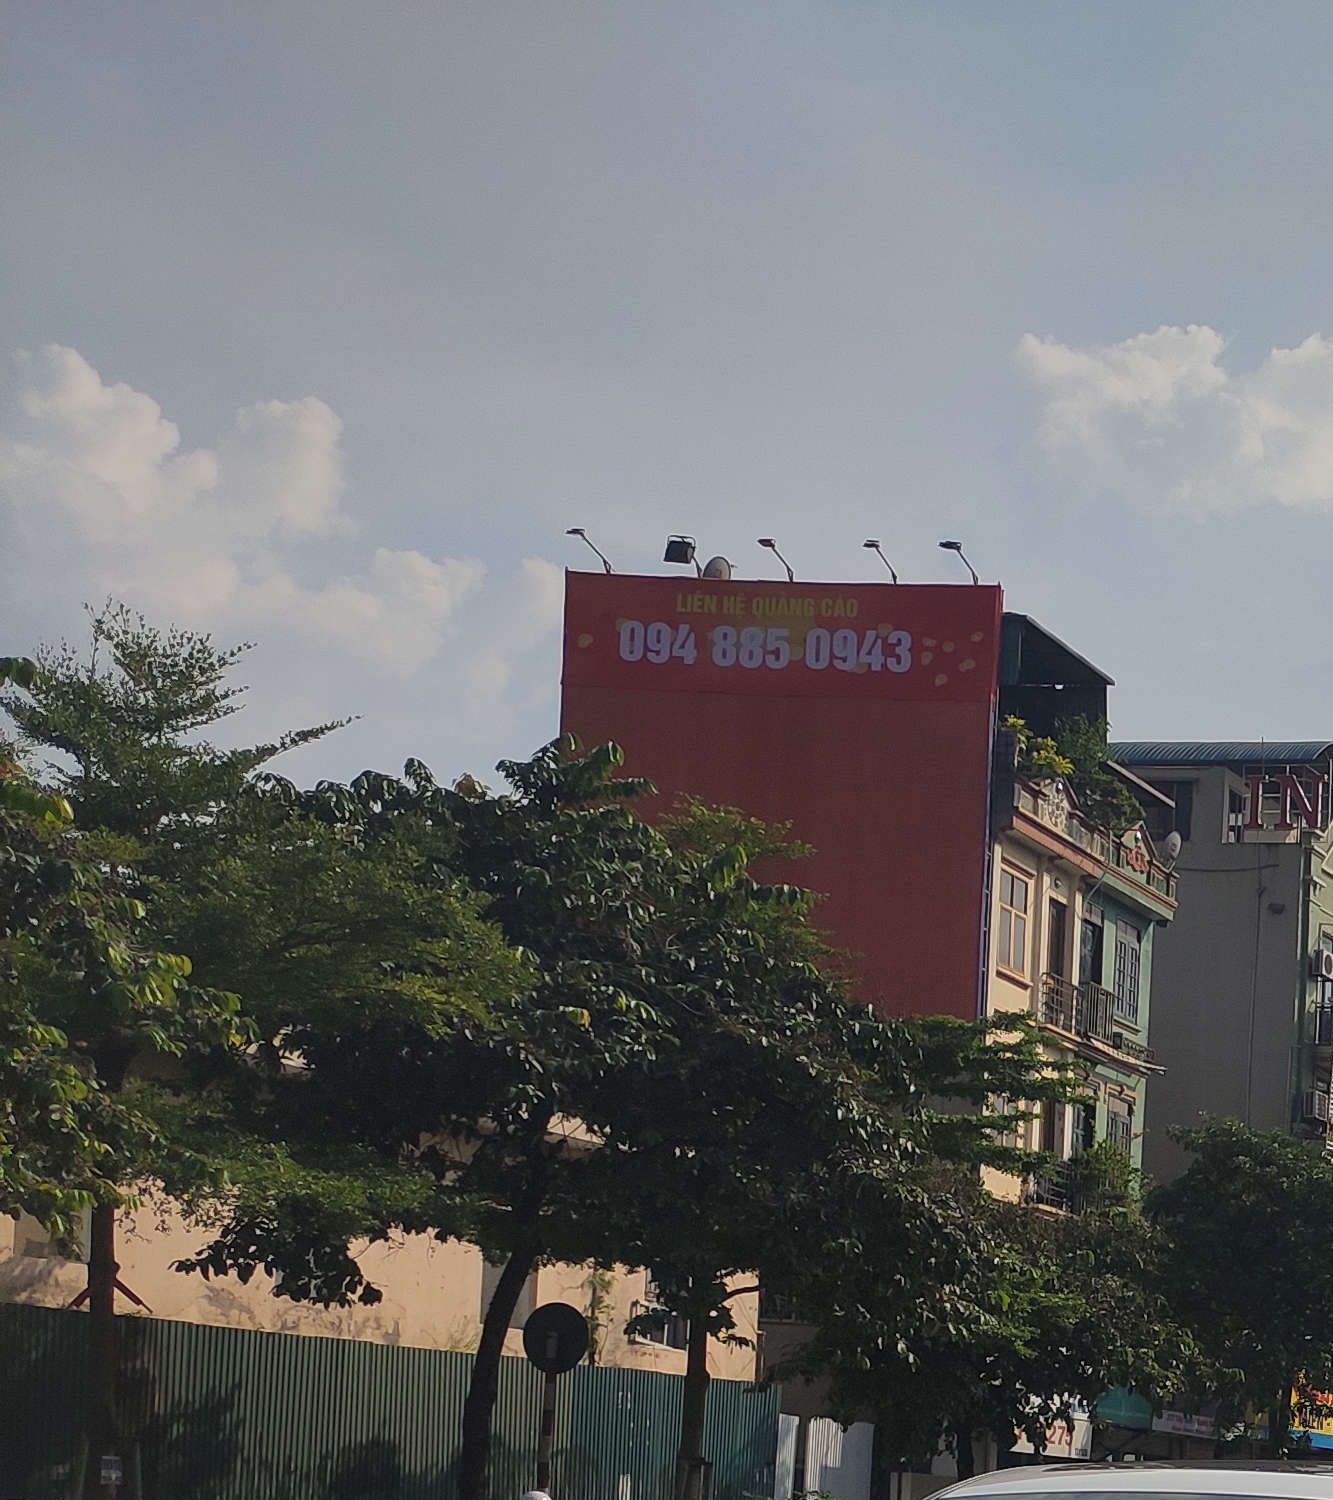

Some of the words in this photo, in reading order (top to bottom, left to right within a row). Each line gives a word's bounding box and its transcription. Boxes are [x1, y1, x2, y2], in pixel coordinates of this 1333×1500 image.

[676, 592, 716, 613] LIÊN
[723, 593, 745, 616] HỆ
[821, 595, 859, 618] CÁO
[618, 619, 698, 665] 094
[711, 624, 791, 669] 885
[804, 627, 913, 673] 0943
[1243, 774, 1328, 830] IN
